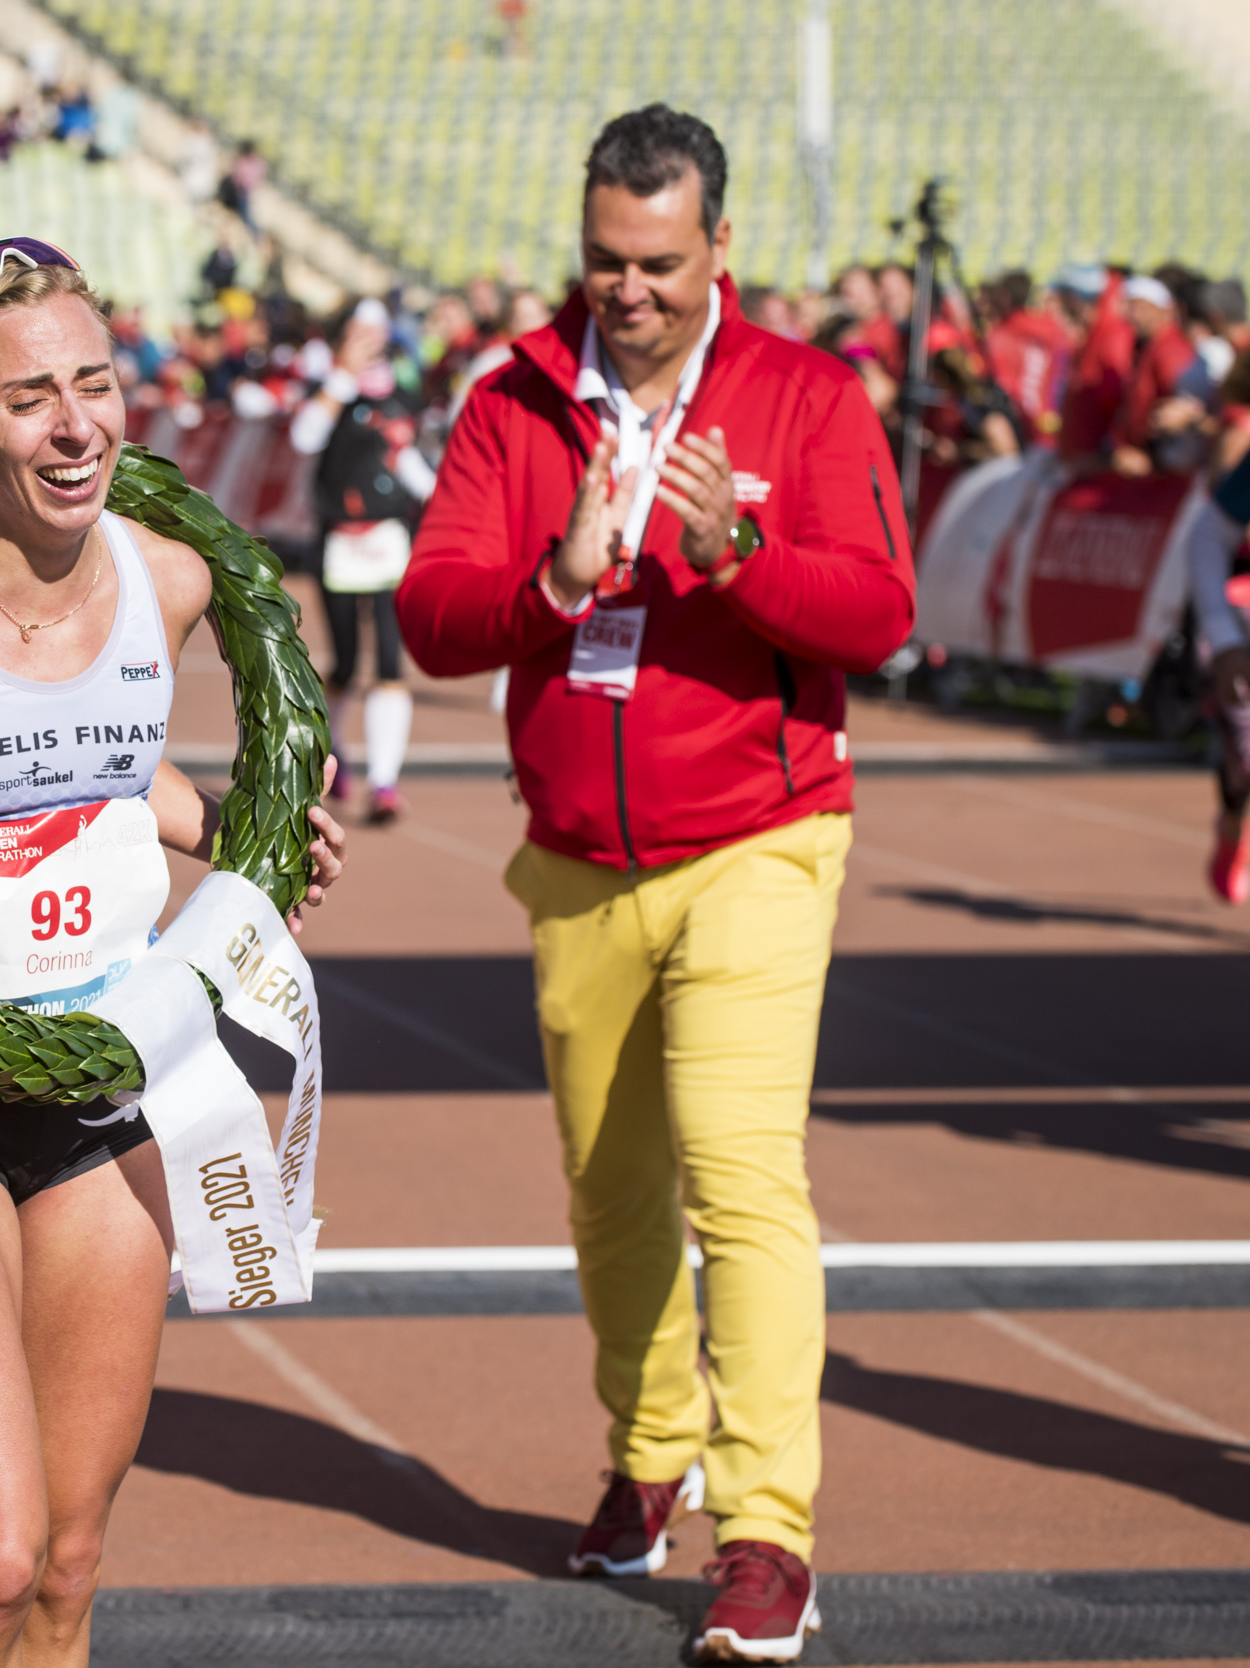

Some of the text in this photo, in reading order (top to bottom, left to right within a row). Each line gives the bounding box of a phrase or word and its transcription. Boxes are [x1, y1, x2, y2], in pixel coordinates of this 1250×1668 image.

[121, 662, 160, 679] PEPPEX
[75, 722, 165, 745] FINANZ
[31, 885, 92, 941] 93
[26, 950, 93, 975] Corinna
[225, 922, 314, 1062] GENERALI
[198, 1152, 278, 1310] Sieger 2021
